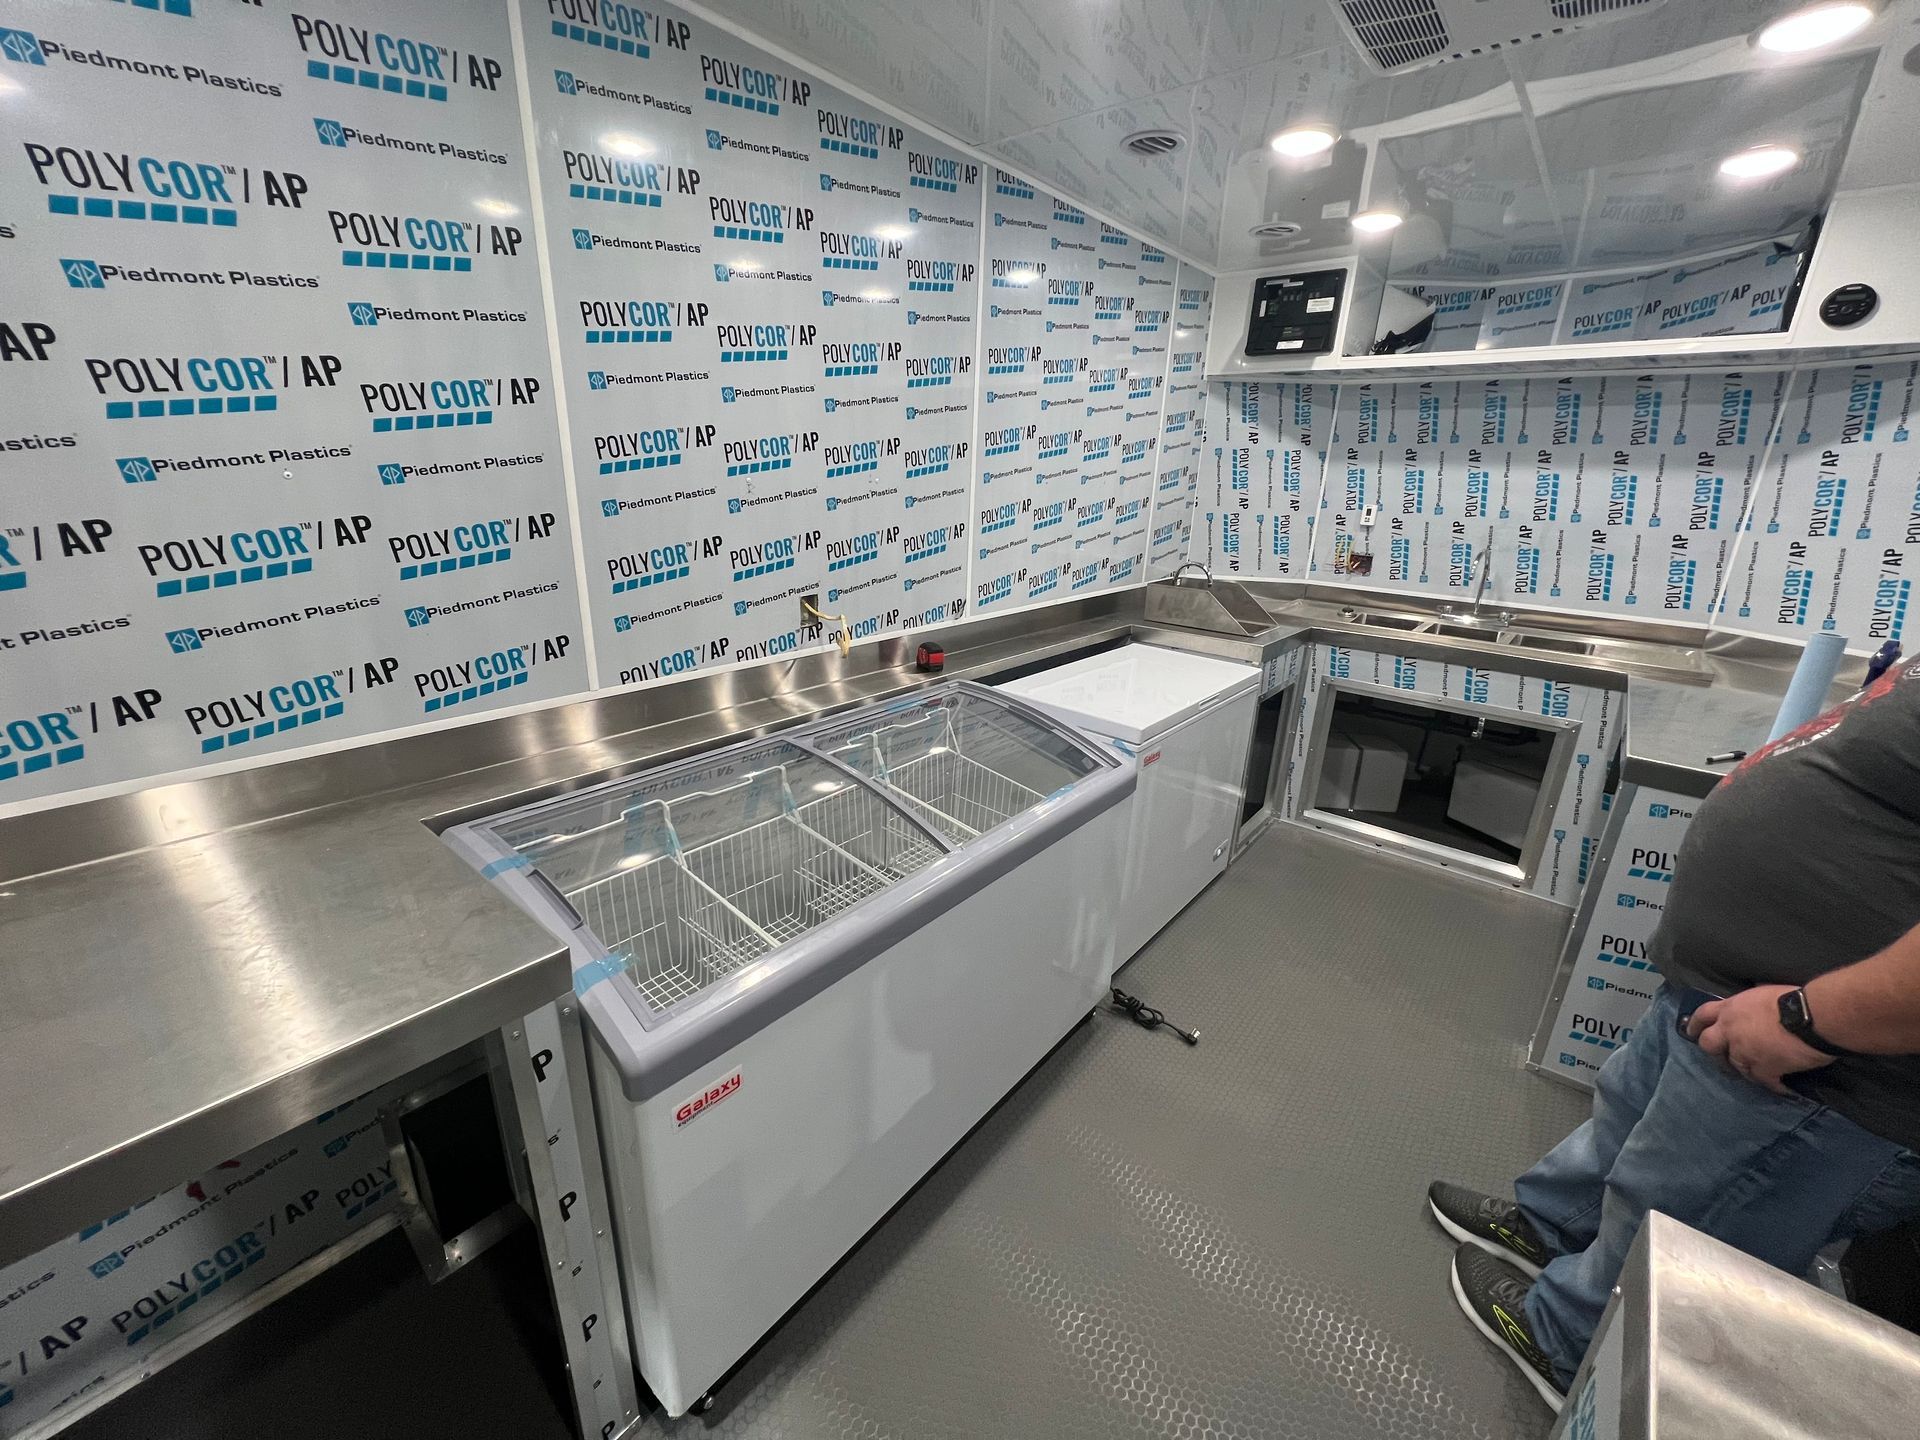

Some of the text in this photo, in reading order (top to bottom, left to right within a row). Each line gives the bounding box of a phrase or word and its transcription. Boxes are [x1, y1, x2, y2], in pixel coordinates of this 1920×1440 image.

[667, 18, 691, 51] AP
[38, 39, 282, 97] Piedmont Plastics
[469, 56, 502, 92] AP
[576, 80, 692, 115] Piedmont Plastics
[792, 80, 811, 107] AP
[342, 128, 507, 165] Piedmont Plastics
[721, 136, 810, 161] Piedmont Plastics
[889, 128, 904, 150] AP
[263, 170, 308, 209] AP
[678, 167, 700, 195] AP
[796, 207, 814, 231] AP
[917, 211, 974, 228] Piedmont Plastics
[1002, 218, 1027, 228] Piedmont
[490, 226, 522, 256] AP
[592, 234, 701, 254] Piedmont Plastics
[100, 264, 319, 288] Piedmont Plastics
[1085, 282, 1094, 296] AP
[1731, 284, 1751, 301] AP
[1751, 286, 1786, 307] POLY
[374, 307, 526, 323] Piedmont Plastics
[687, 302, 708, 326] AP
[997, 308, 1021, 316] Piedmont
[1644, 300, 1661, 316] AP
[0, 323, 56, 361] AP
[1031, 346, 1041, 362] AP
[300, 355, 343, 388] AP
[606, 370, 710, 385] Piedmont Plastics
[510, 378, 541, 405] AP
[0, 434, 76, 452] stics
[695, 424, 716, 448] AP
[1027, 425, 1037, 440] AP
[151, 446, 351, 474] Piedmont Plastics
[402, 454, 543, 478] Piedmont Plastics
[1405, 448, 1417, 462] AP
[1469, 449, 1481, 462] AP
[618, 486, 717, 510] Piedmont Plastics
[1239, 498, 1248, 510] AP
[1861, 488, 1875, 528] Piedmont
[57, 519, 113, 557] AP
[333, 515, 373, 547] AP
[527, 512, 556, 540] AP
[953, 523, 965, 540] AP
[702, 535, 723, 558] AP
[1789, 541, 1806, 558] AP
[1882, 549, 1903, 566] AP
[1017, 568, 1027, 584] AP
[1629, 563, 1638, 595] Piedmont
[426, 582, 559, 618] Piedmont Plastics
[630, 592, 723, 626] Piedmont Plastics
[1827, 580, 1840, 619] Piedmont
[20, 616, 130, 645] Plastics
[197, 595, 380, 641] Piedmont Plastics
[543, 635, 570, 662] AP
[363, 657, 400, 688] AP
[112, 689, 162, 727] AP
[1552, 681, 1570, 717] LYCOR
[1575, 764, 1586, 794] Piedmont
[1601, 935, 1647, 959] POLY
[1605, 982, 1653, 1000] Piedm
[677, 1073, 741, 1121] Galaxy
[335, 1160, 393, 1208] POLY
[284, 1189, 320, 1225] AP
[122, 1194, 222, 1258] Piedmont
[39, 1315, 88, 1360] AP
